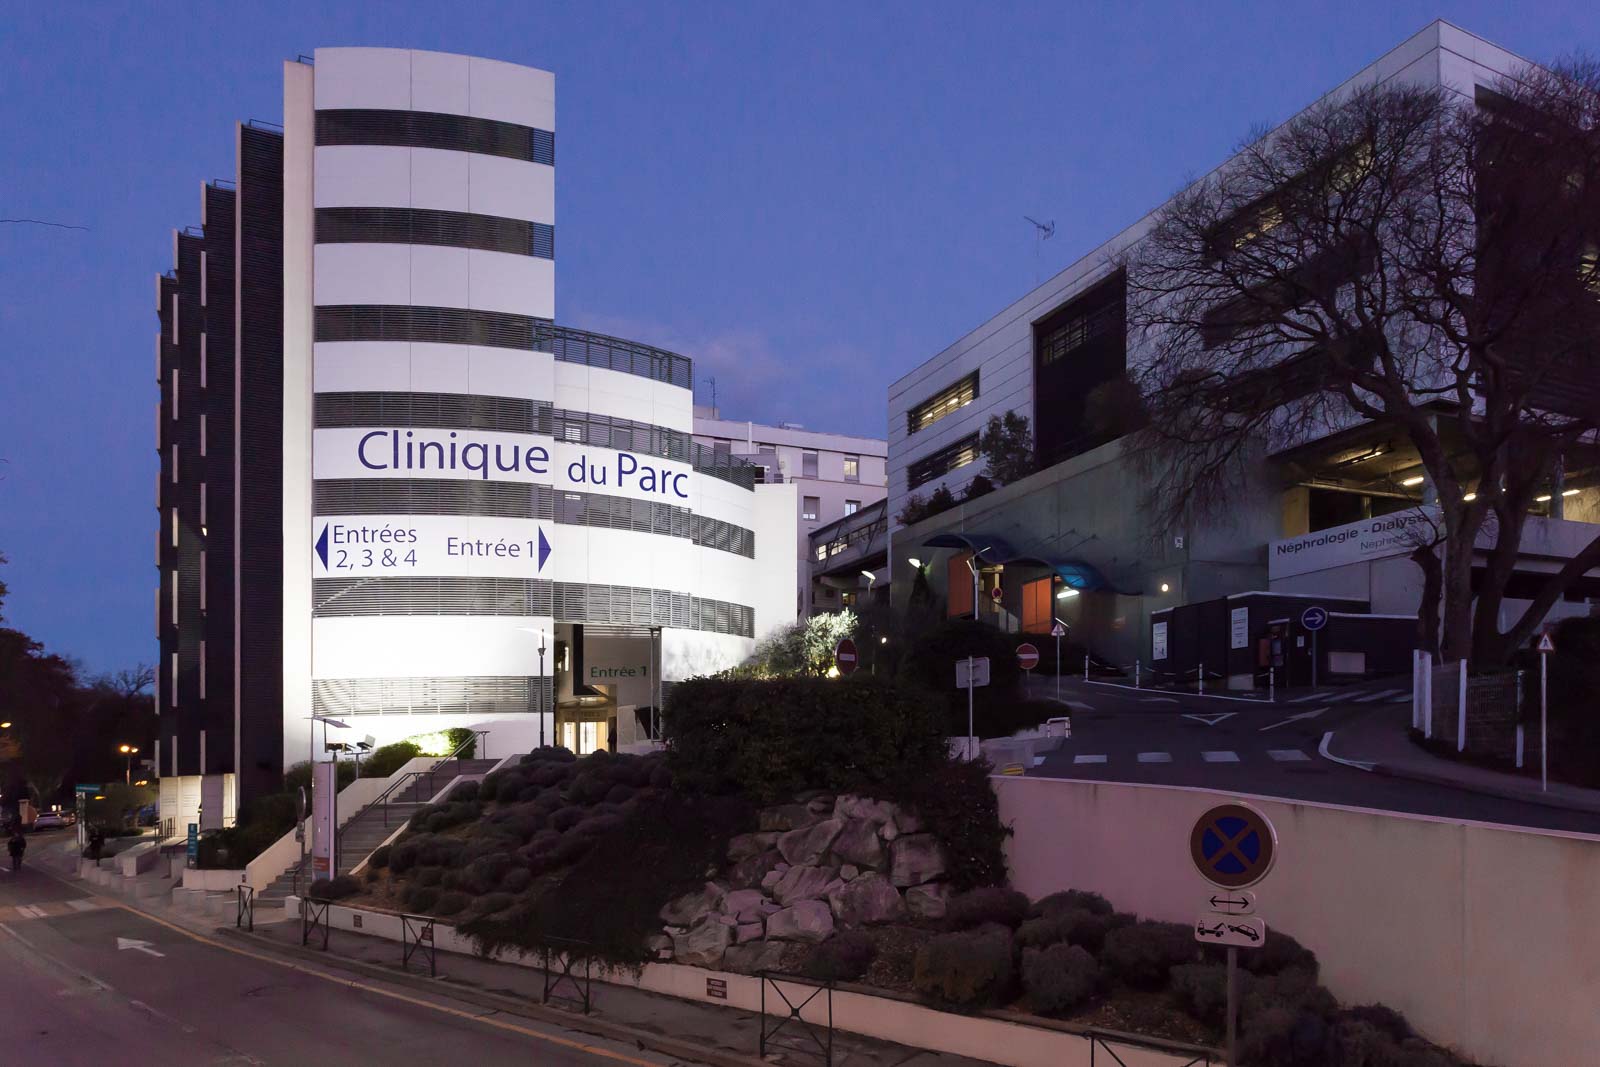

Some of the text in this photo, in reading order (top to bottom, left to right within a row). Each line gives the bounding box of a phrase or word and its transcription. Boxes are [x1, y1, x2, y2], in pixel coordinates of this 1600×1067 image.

[358, 430, 688, 498] Clinique du Parc
[333, 523, 417, 544] Entrées
[1277, 528, 1358, 555] Néphrologie
[447, 537, 534, 558] Entrée 1
[336, 548, 418, 570] 2, 3 & 4
[590, 665, 647, 678] Entrée 1
